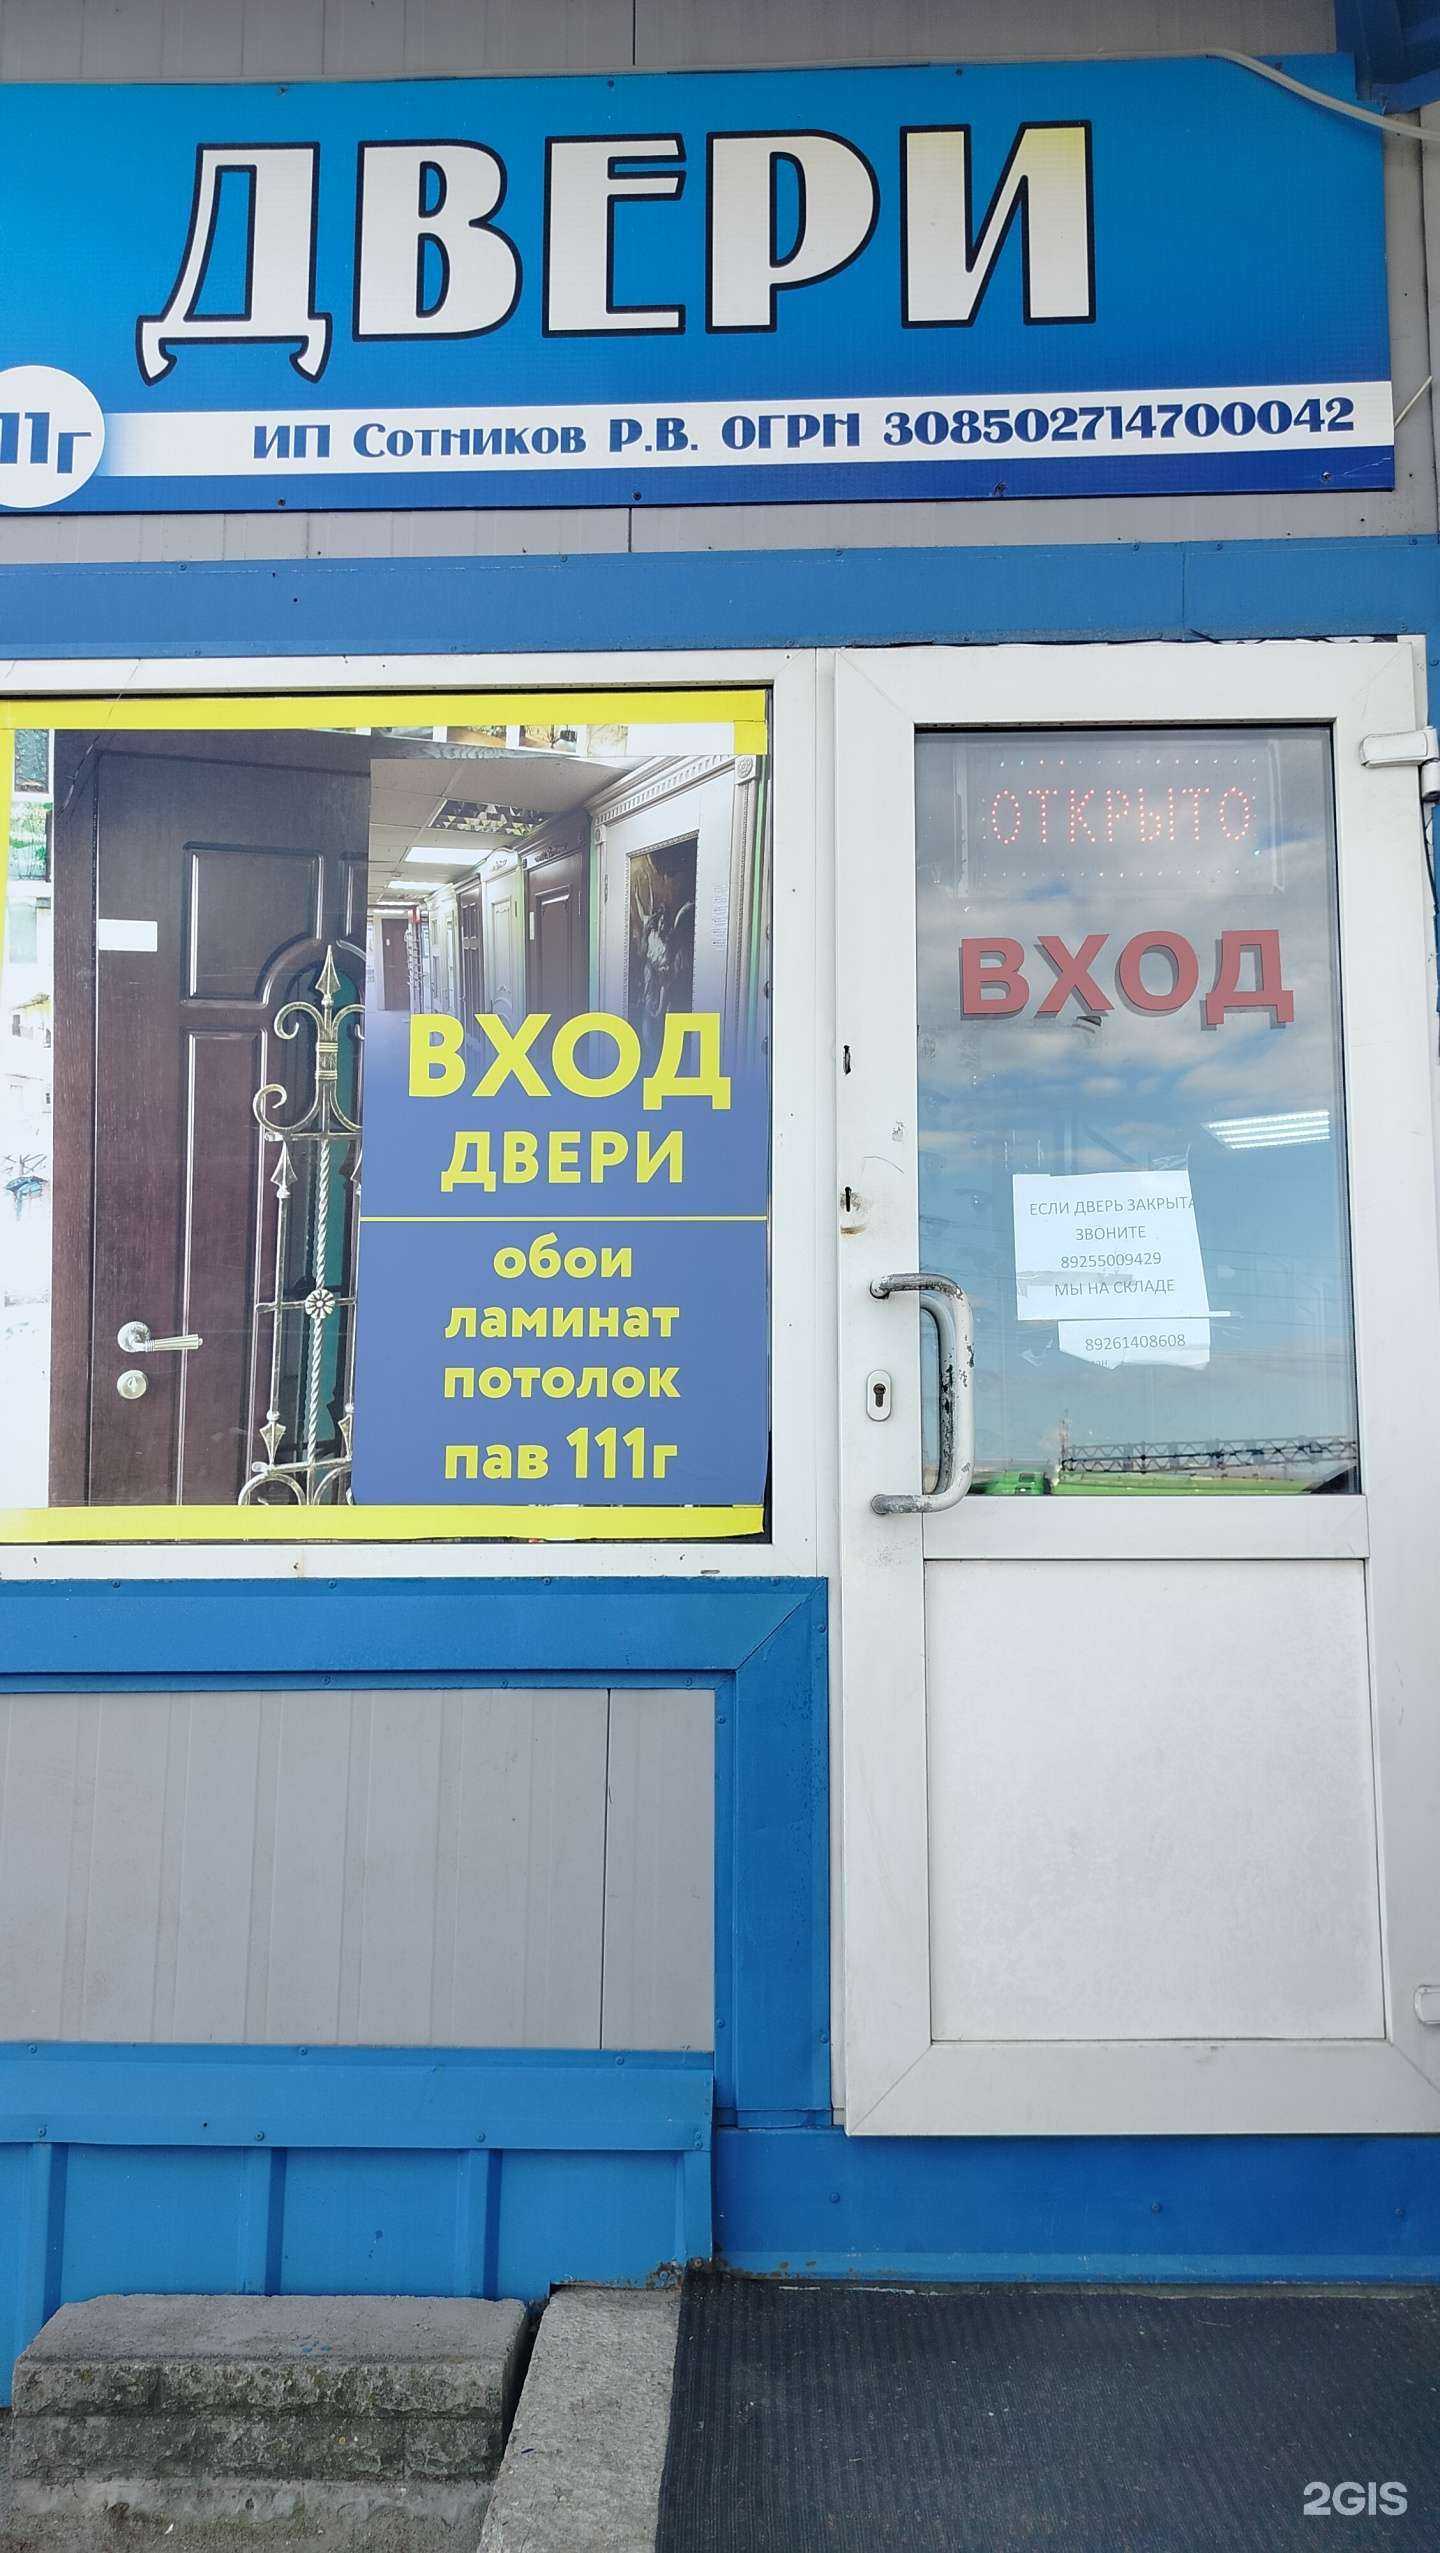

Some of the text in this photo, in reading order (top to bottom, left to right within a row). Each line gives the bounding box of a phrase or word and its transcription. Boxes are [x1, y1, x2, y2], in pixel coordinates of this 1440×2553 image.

[135, 120, 1097, 386] ДВЕРИ
[253, 396, 1355, 459] ИП Сотников Р.В. ОГРН 308502714700042
[990, 786, 1252, 845] ОТКРЫТО
[960, 929, 1295, 1030] ВХОД
[408, 1011, 732, 1111] ВХОД
[440, 1131, 684, 1193] ДВЕРИ
[1030, 1202, 1070, 1216] ЕСЛИ
[1074, 1199, 1124, 1217] ДВЕРЬ
[493, 1232, 633, 1279] обои
[1075, 1226, 1147, 1241] ЗВОНИТЕ
[1060, 1252, 1163, 1269] 89255009429
[1055, 1279, 1176, 1297] МЫ НА СКЛАДЕ
[444, 1306, 681, 1339] ламинат
[1085, 1334, 1187, 1351] 89261408608
[443, 1366, 681, 1399] потолок
[444, 1427, 678, 1480] пав 111г
